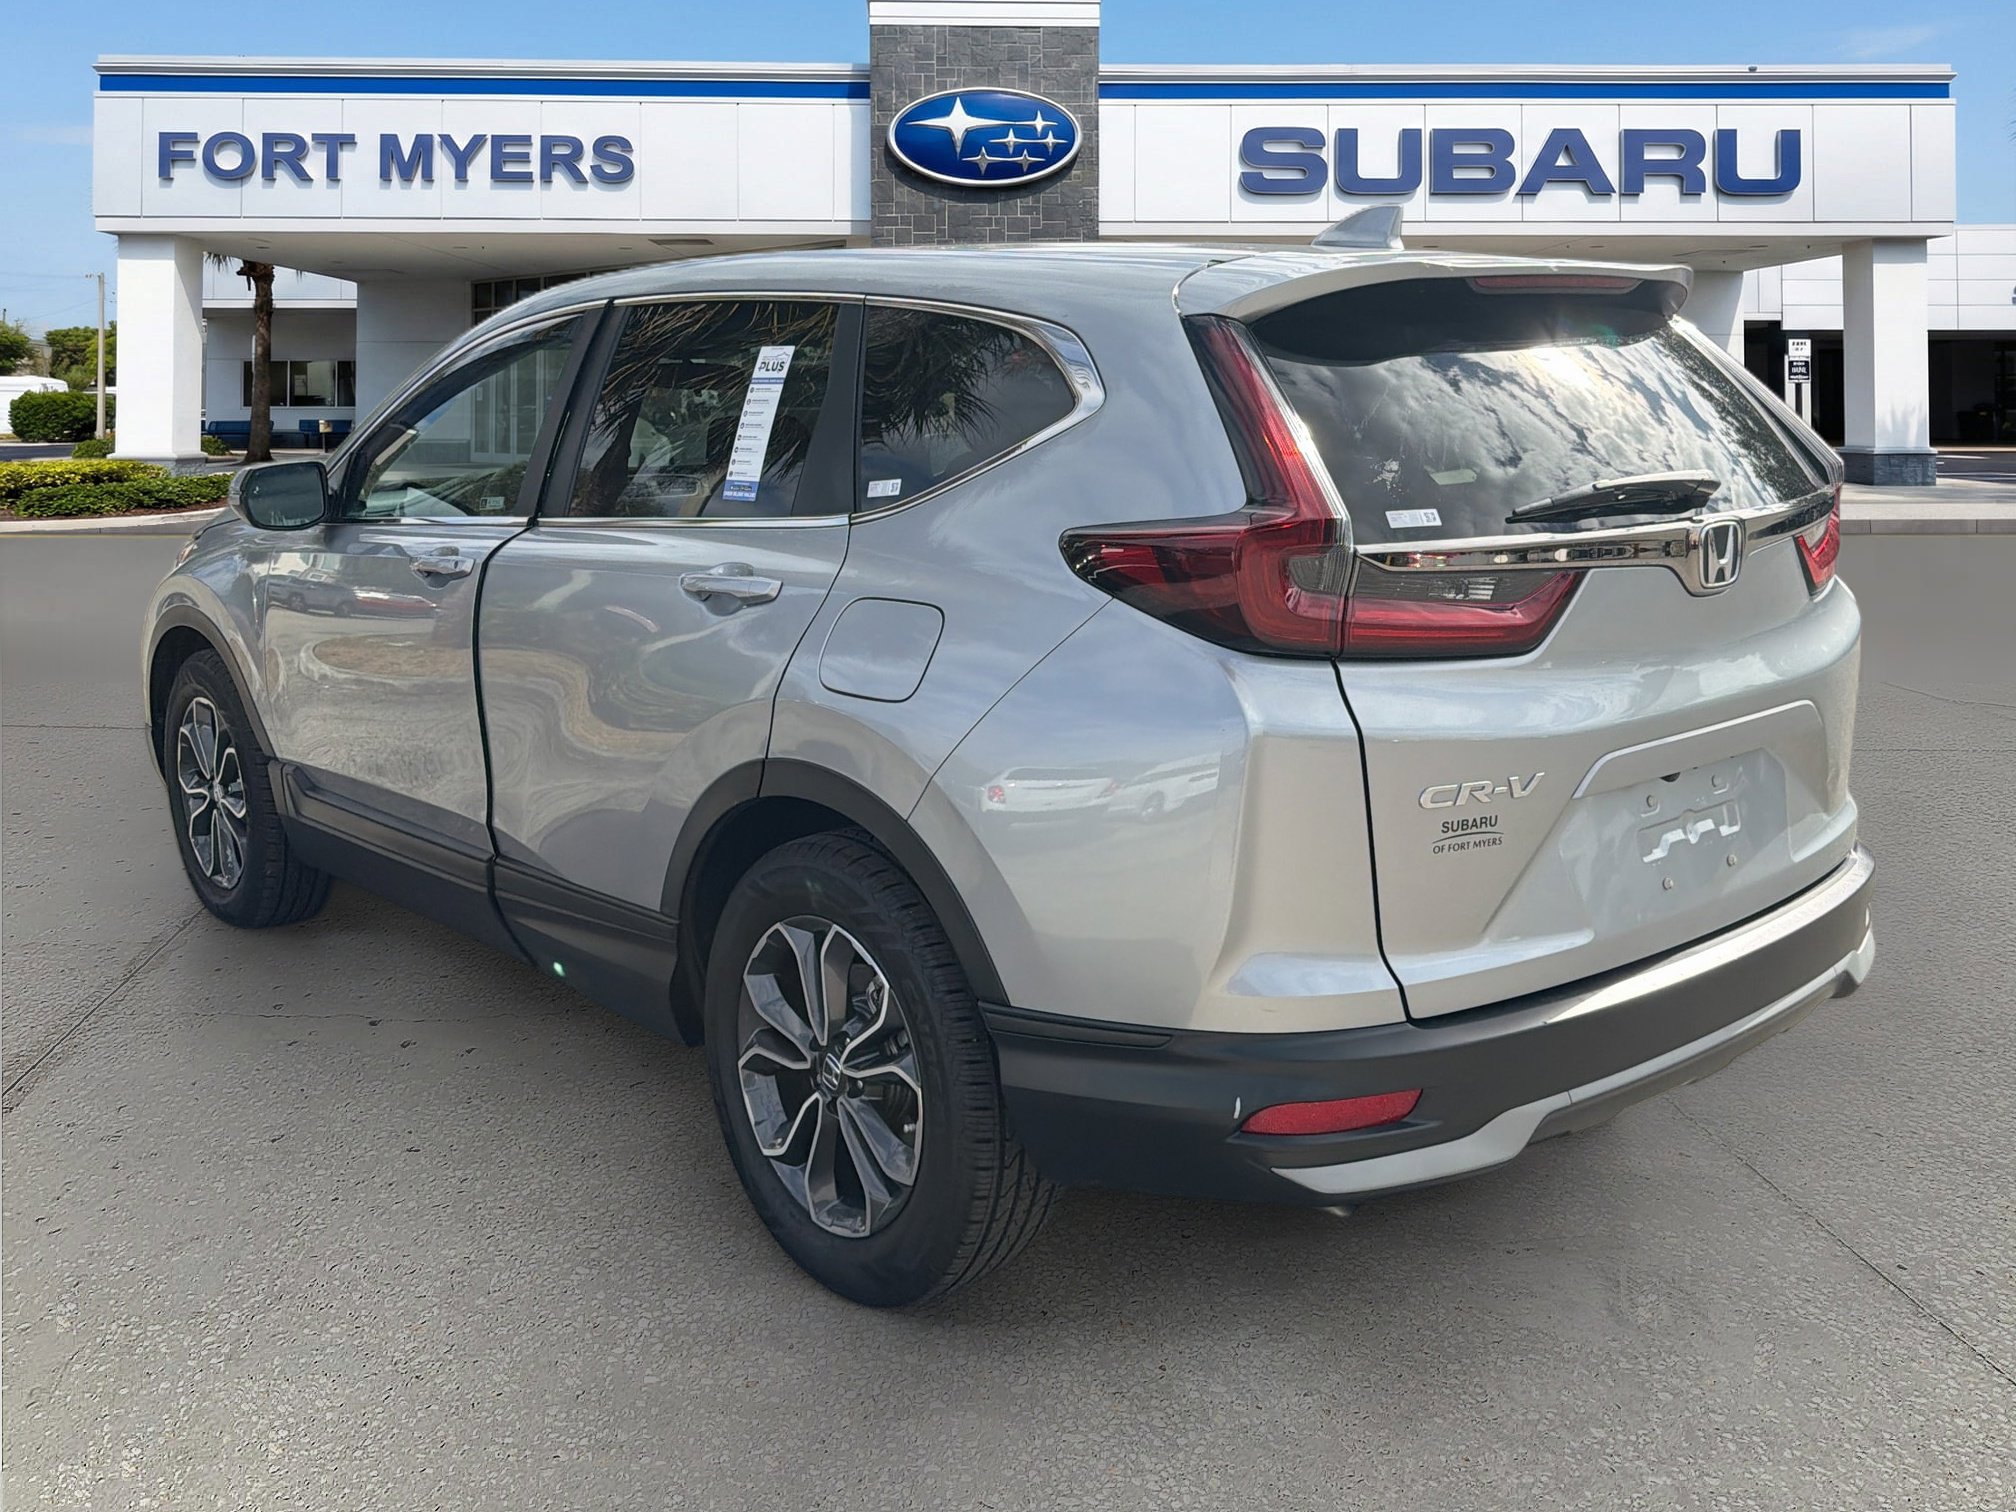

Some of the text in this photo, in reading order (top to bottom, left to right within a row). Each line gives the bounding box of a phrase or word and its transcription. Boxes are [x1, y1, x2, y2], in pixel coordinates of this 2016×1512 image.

[158, 132, 635, 184] FORT MYERS
[1240, 127, 1801, 195] SUBARU
[758, 361, 785, 372] PLUS
[1419, 772, 1545, 809] CR-V
[1441, 815, 1498, 833] SUBARU
[1433, 837, 1503, 855] OF FORT MYERS
